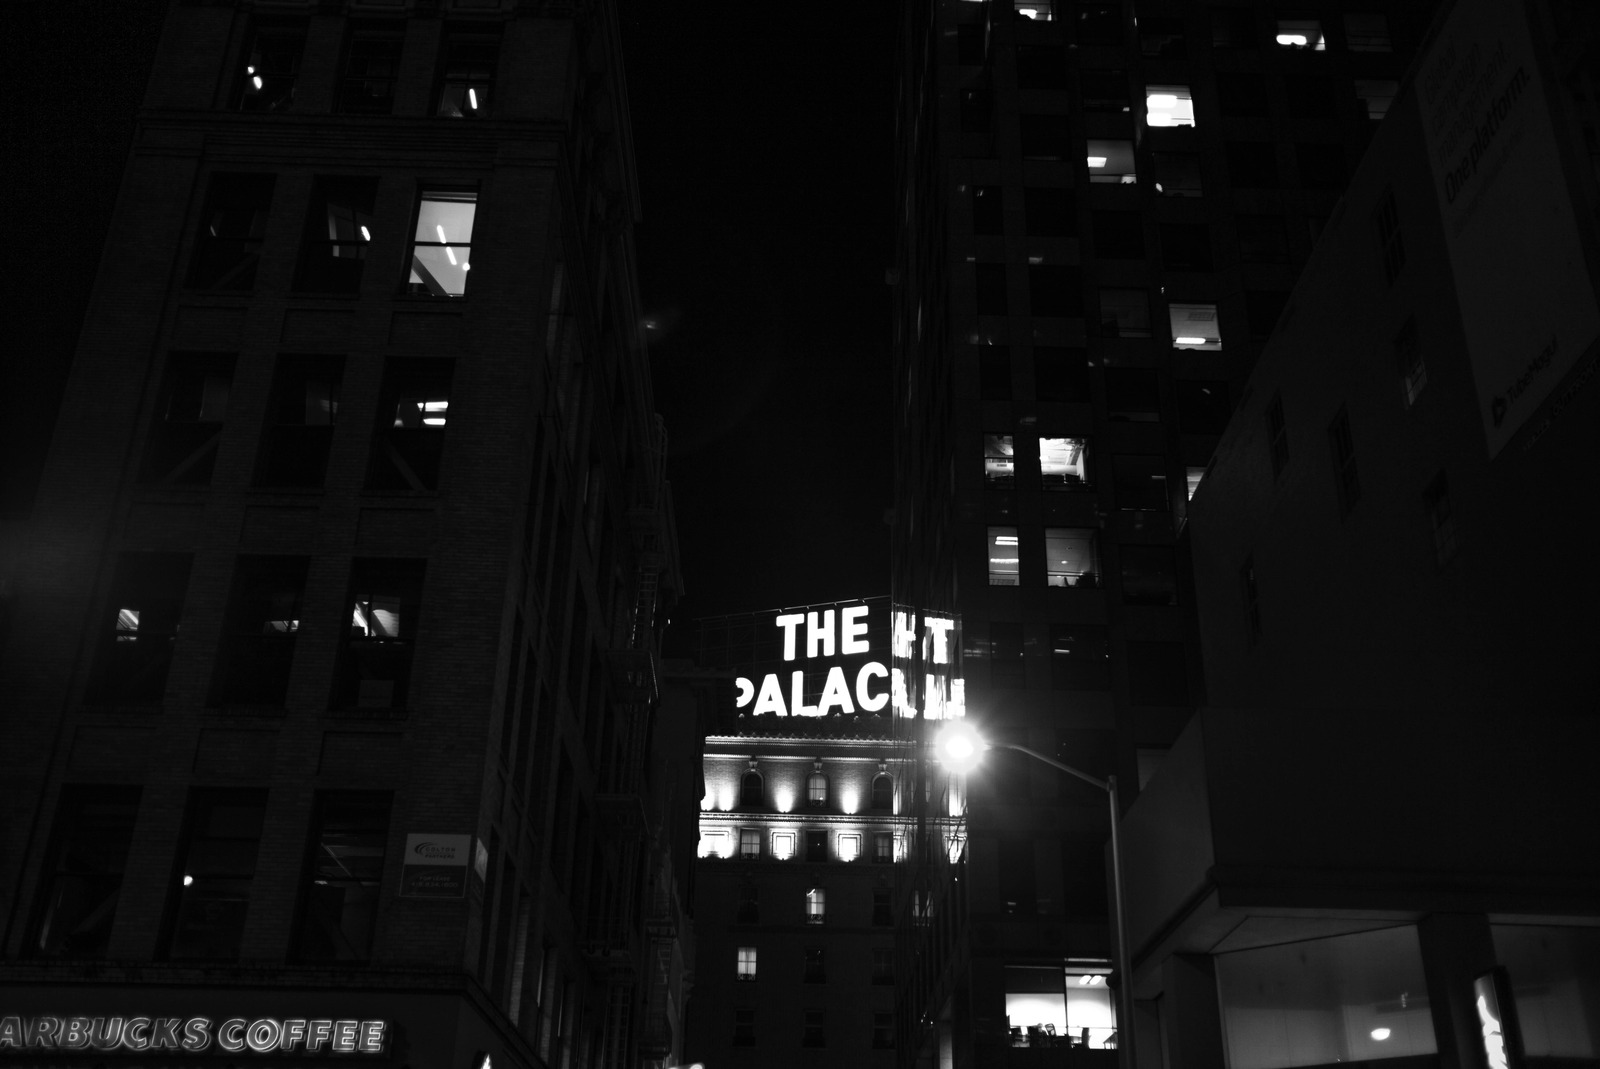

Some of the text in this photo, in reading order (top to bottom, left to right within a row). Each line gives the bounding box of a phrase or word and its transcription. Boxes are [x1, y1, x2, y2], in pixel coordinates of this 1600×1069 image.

[1434, 43, 1481, 136] campaign
[1445, 156, 1470, 204] One
[1469, 66, 1530, 174] platform.
[776, 605, 870, 661] THE
[0, 1016, 385, 1053] ARBUCKS COFFEE
